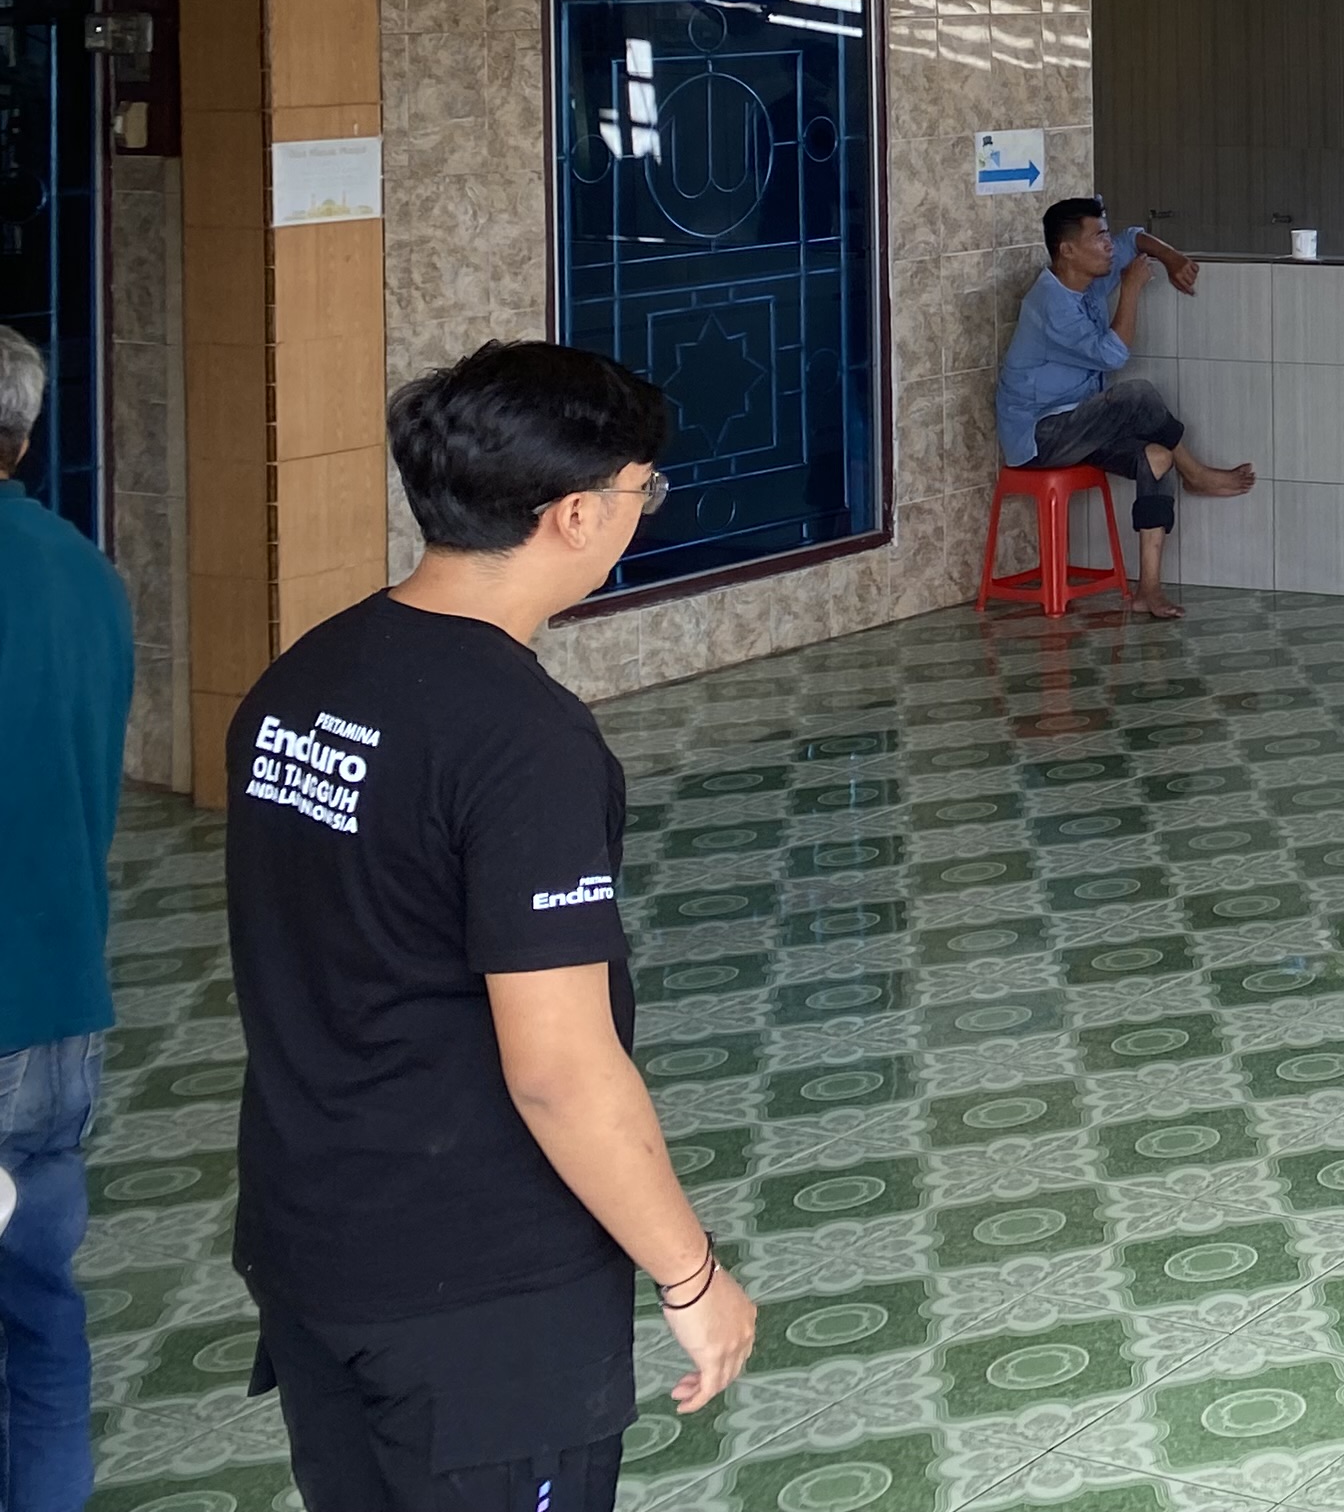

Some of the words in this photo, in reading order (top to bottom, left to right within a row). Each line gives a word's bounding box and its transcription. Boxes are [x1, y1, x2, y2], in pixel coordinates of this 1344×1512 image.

[314, 711, 381, 747] PERTAMINA
[255, 715, 367, 783] Enduro
[252, 755, 282, 783] OLI
[533, 886, 614, 910] Enduro
